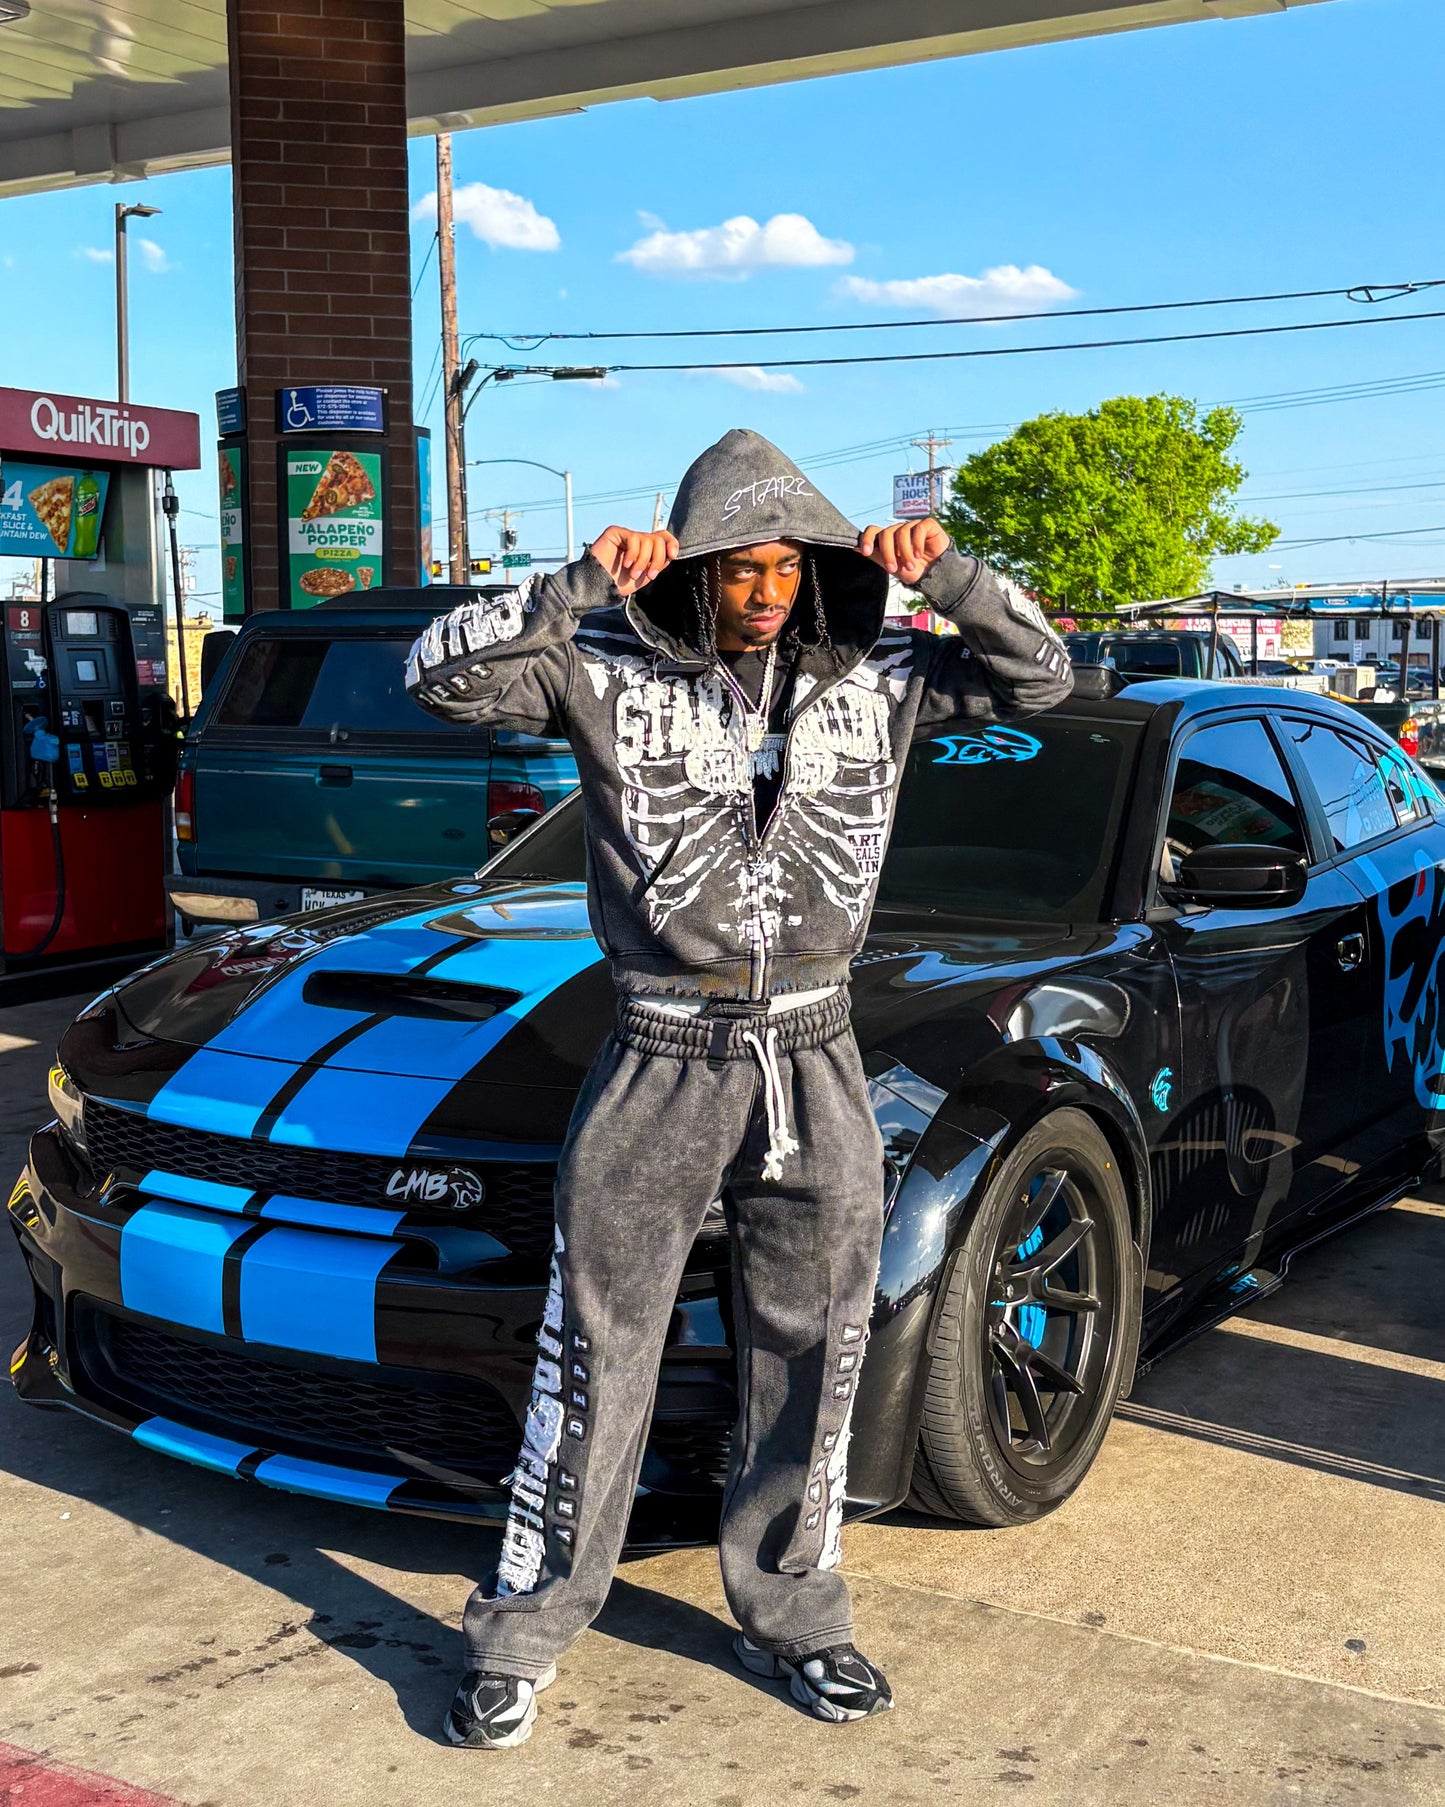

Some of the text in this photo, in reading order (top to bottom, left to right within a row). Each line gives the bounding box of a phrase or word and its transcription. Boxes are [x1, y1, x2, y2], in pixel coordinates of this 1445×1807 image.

[31, 397, 150, 458] QuikTrip
[295, 464, 319, 473] NEW
[902, 488, 930, 500] HOUS
[2, 521, 26, 530] SLICE
[298, 522, 375, 536] JALAPEÑO
[29, 531, 48, 541] DEW
[307, 535, 367, 546] POPPER
[322, 549, 353, 557] PIZZA
[20, 610, 30, 628] 8
[854, 847, 880, 860] EALS
[322, 890, 346, 900] TEXAS
[386, 1169, 449, 1201] CMB
[569, 1336, 589, 1438] DEPT
[555, 1473, 577, 1542] ART
